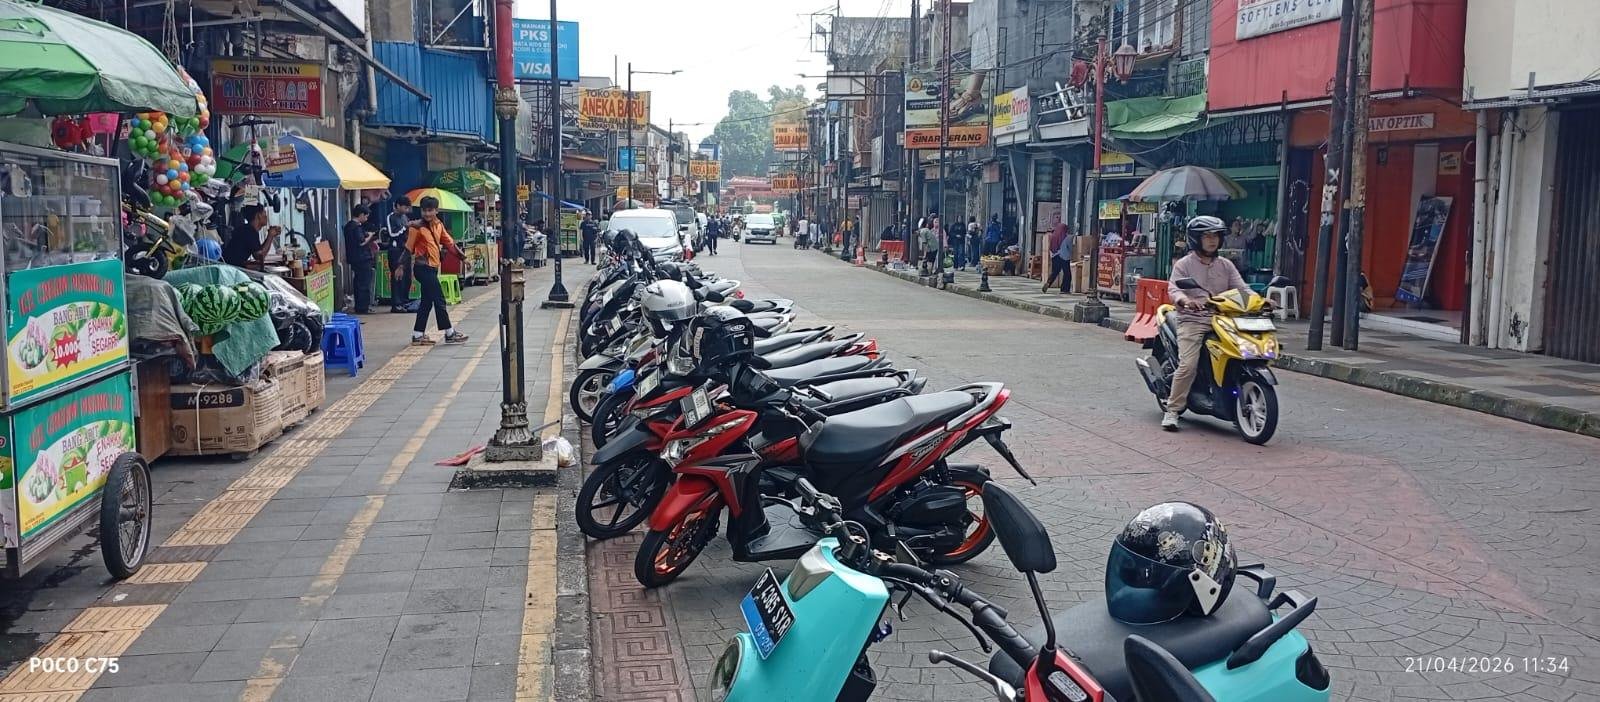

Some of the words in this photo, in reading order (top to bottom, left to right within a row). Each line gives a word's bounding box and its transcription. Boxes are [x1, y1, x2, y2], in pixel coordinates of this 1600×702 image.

[1239, 0, 1298, 24] SOFTLENS
[520, 30, 548, 41] PKS
[233, 64, 259, 72] TOKO
[263, 65, 300, 74] MAINAN
[520, 62, 552, 75] VISA
[586, 90, 610, 98] TOKO
[582, 97, 616, 117] ANEKA
[617, 99, 645, 119] BARU
[1387, 115, 1425, 128] OPTIK
[912, 135, 940, 143] SINAR
[53, 307, 75, 325] BANG
[54, 341, 78, 360] 10.000
[62, 435, 82, 453] BANG
[757, 573, 768, 589] B
[772, 606, 791, 636] SXR
